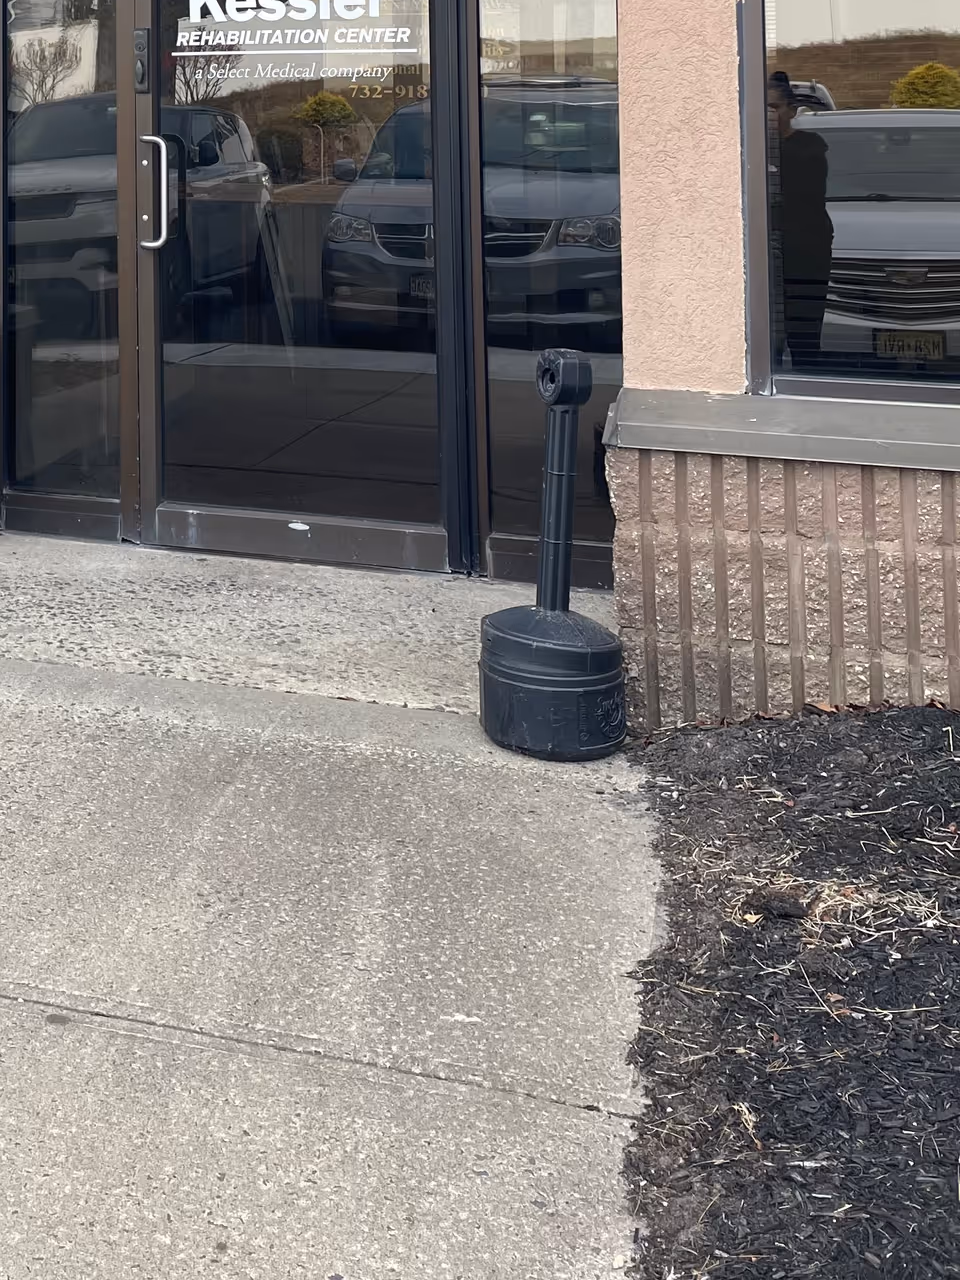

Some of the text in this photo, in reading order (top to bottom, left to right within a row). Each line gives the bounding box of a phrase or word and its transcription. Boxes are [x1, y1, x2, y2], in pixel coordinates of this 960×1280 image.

[176, 27, 411, 46] REHABILITATION CENTER
[195, 63, 392, 82] a Select Medical company
